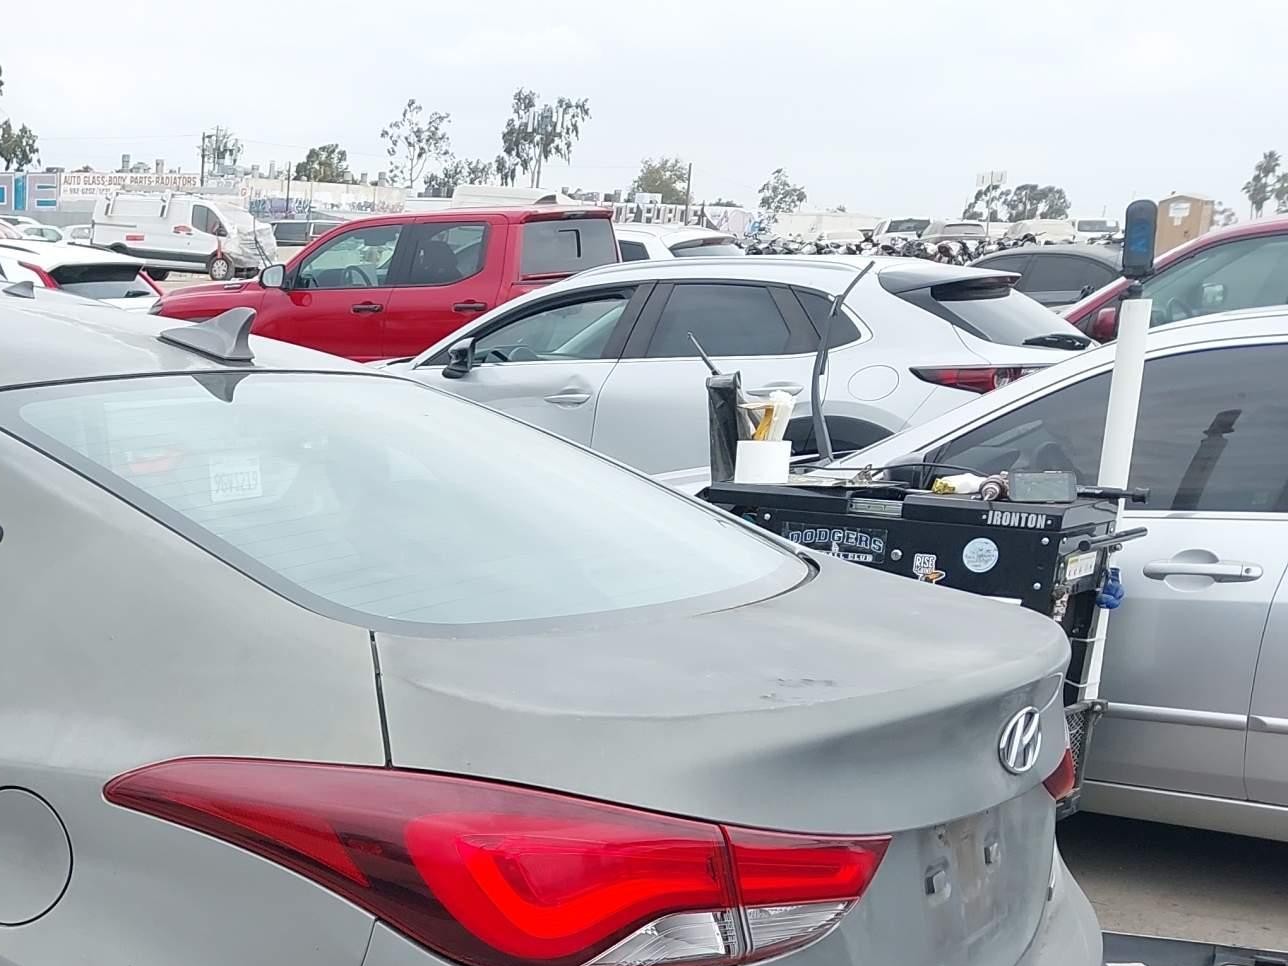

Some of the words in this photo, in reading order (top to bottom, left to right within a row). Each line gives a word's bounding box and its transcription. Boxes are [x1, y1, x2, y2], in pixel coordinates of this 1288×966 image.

[63, 175, 81, 186] AUTO
[789, 529, 883, 552] DODGERS
[916, 556, 934, 568] RISE
